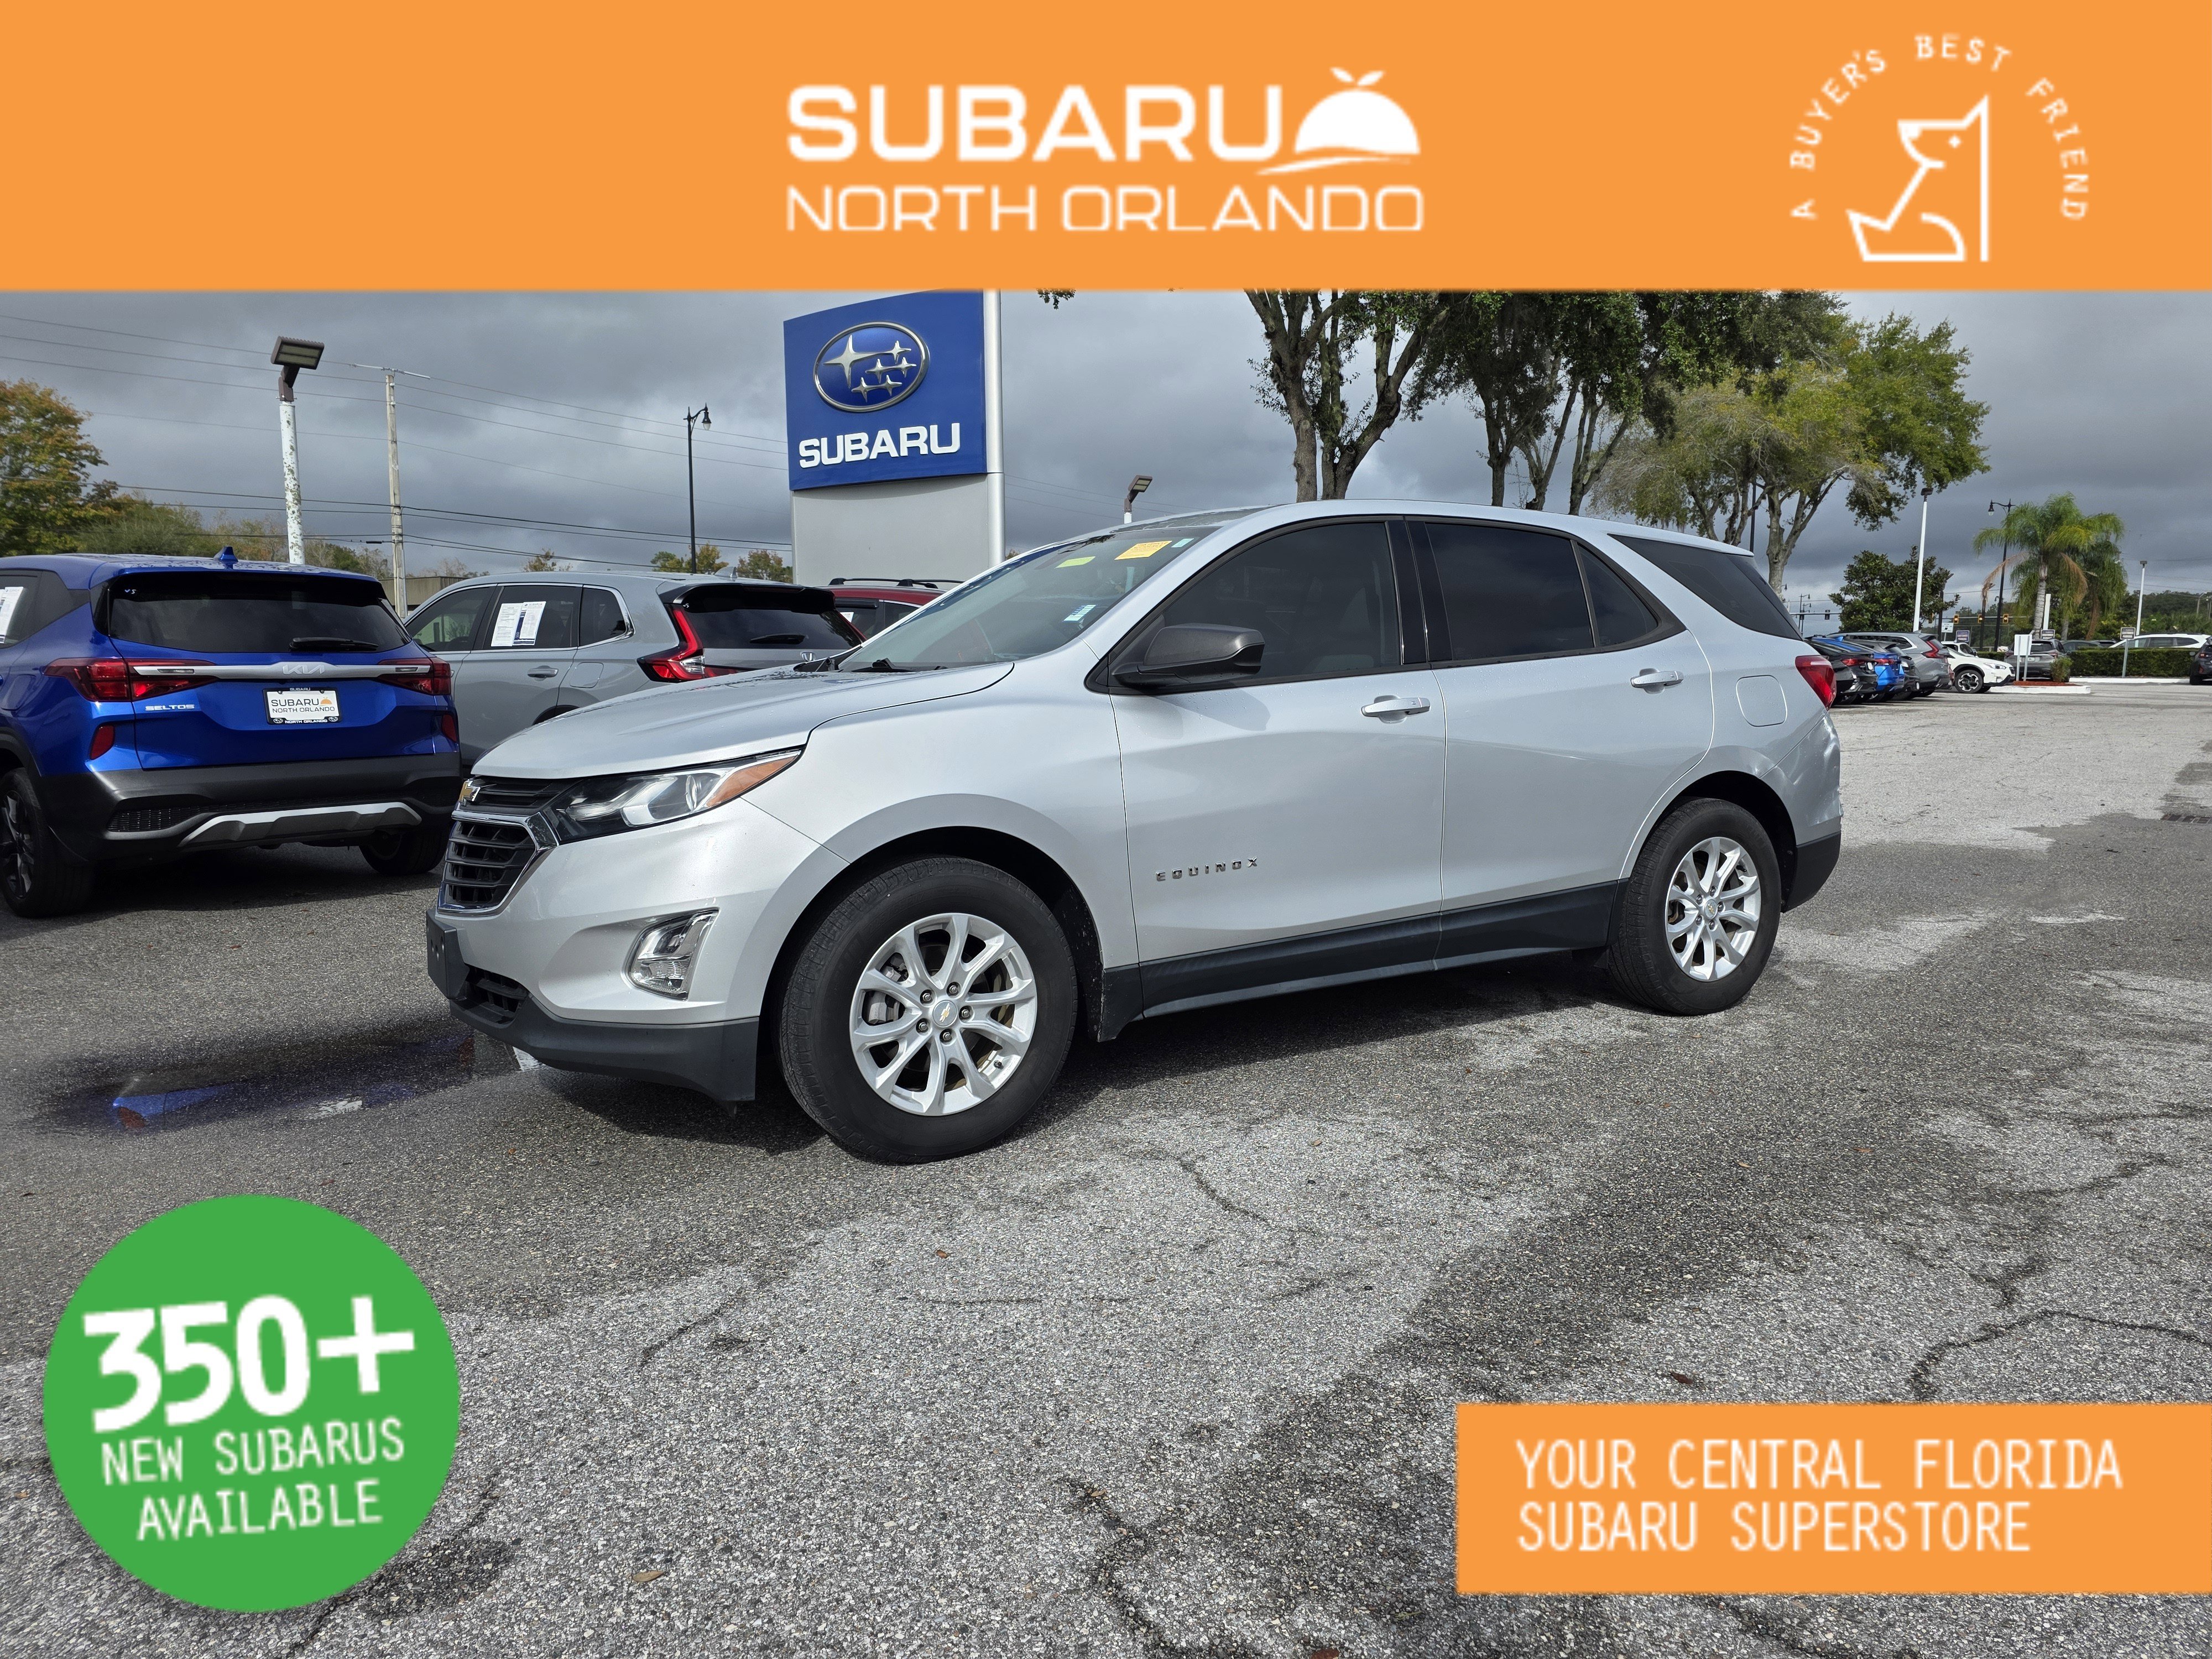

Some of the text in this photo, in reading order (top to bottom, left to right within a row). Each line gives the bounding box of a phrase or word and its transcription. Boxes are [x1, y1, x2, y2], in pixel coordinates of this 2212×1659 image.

[799, 422, 961, 468] SUBARU
[283, 664, 325, 675] KIA
[271, 698, 319, 707] SUBARU
[1156, 857, 1258, 882] EQUINOX
